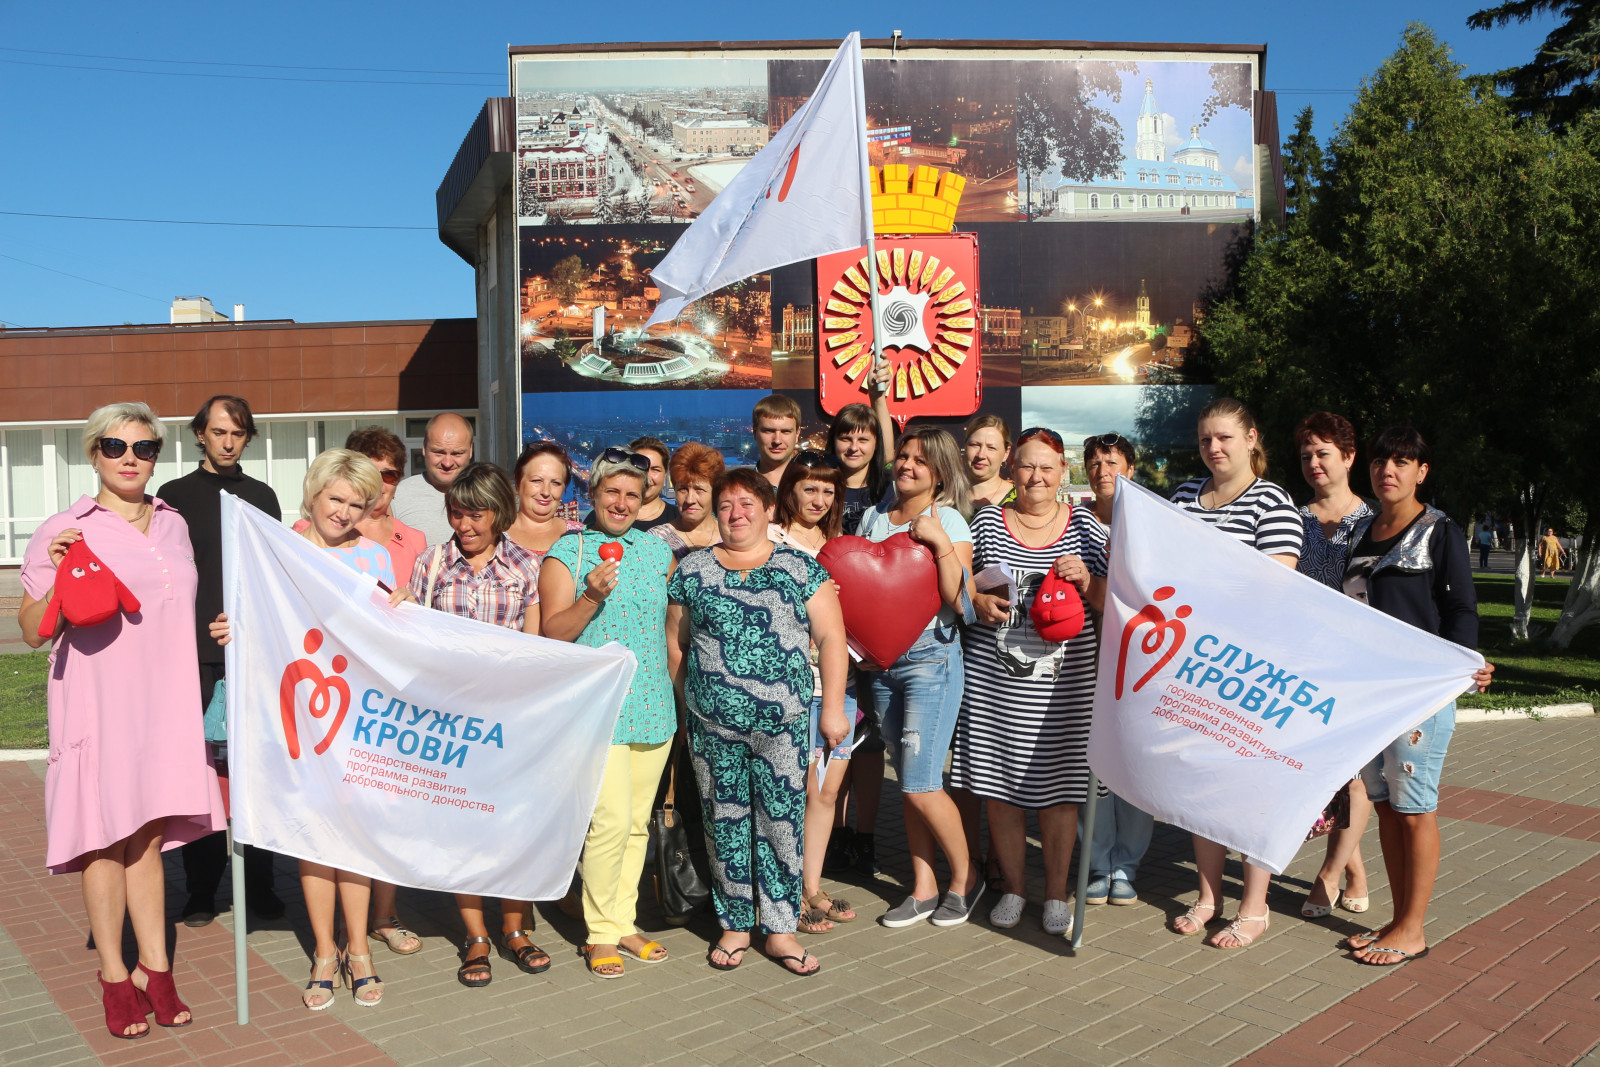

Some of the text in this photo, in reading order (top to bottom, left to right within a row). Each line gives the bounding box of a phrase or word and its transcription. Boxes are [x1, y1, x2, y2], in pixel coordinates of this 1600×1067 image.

[1174, 656, 1295, 730] КРОВИ
[1193, 634, 1336, 726] СЛУЖБА
[361, 688, 504, 749] СЛУЖБА
[1151, 705, 1237, 748] добровольного
[1159, 694, 1278, 757] программа развития
[1165, 683, 1263, 734] государственная
[349, 747, 448, 780] государственная
[353, 715, 469, 769] КРОВИ
[342, 772, 496, 814] добровольного донорства
[346, 760, 467, 796] программа развития
